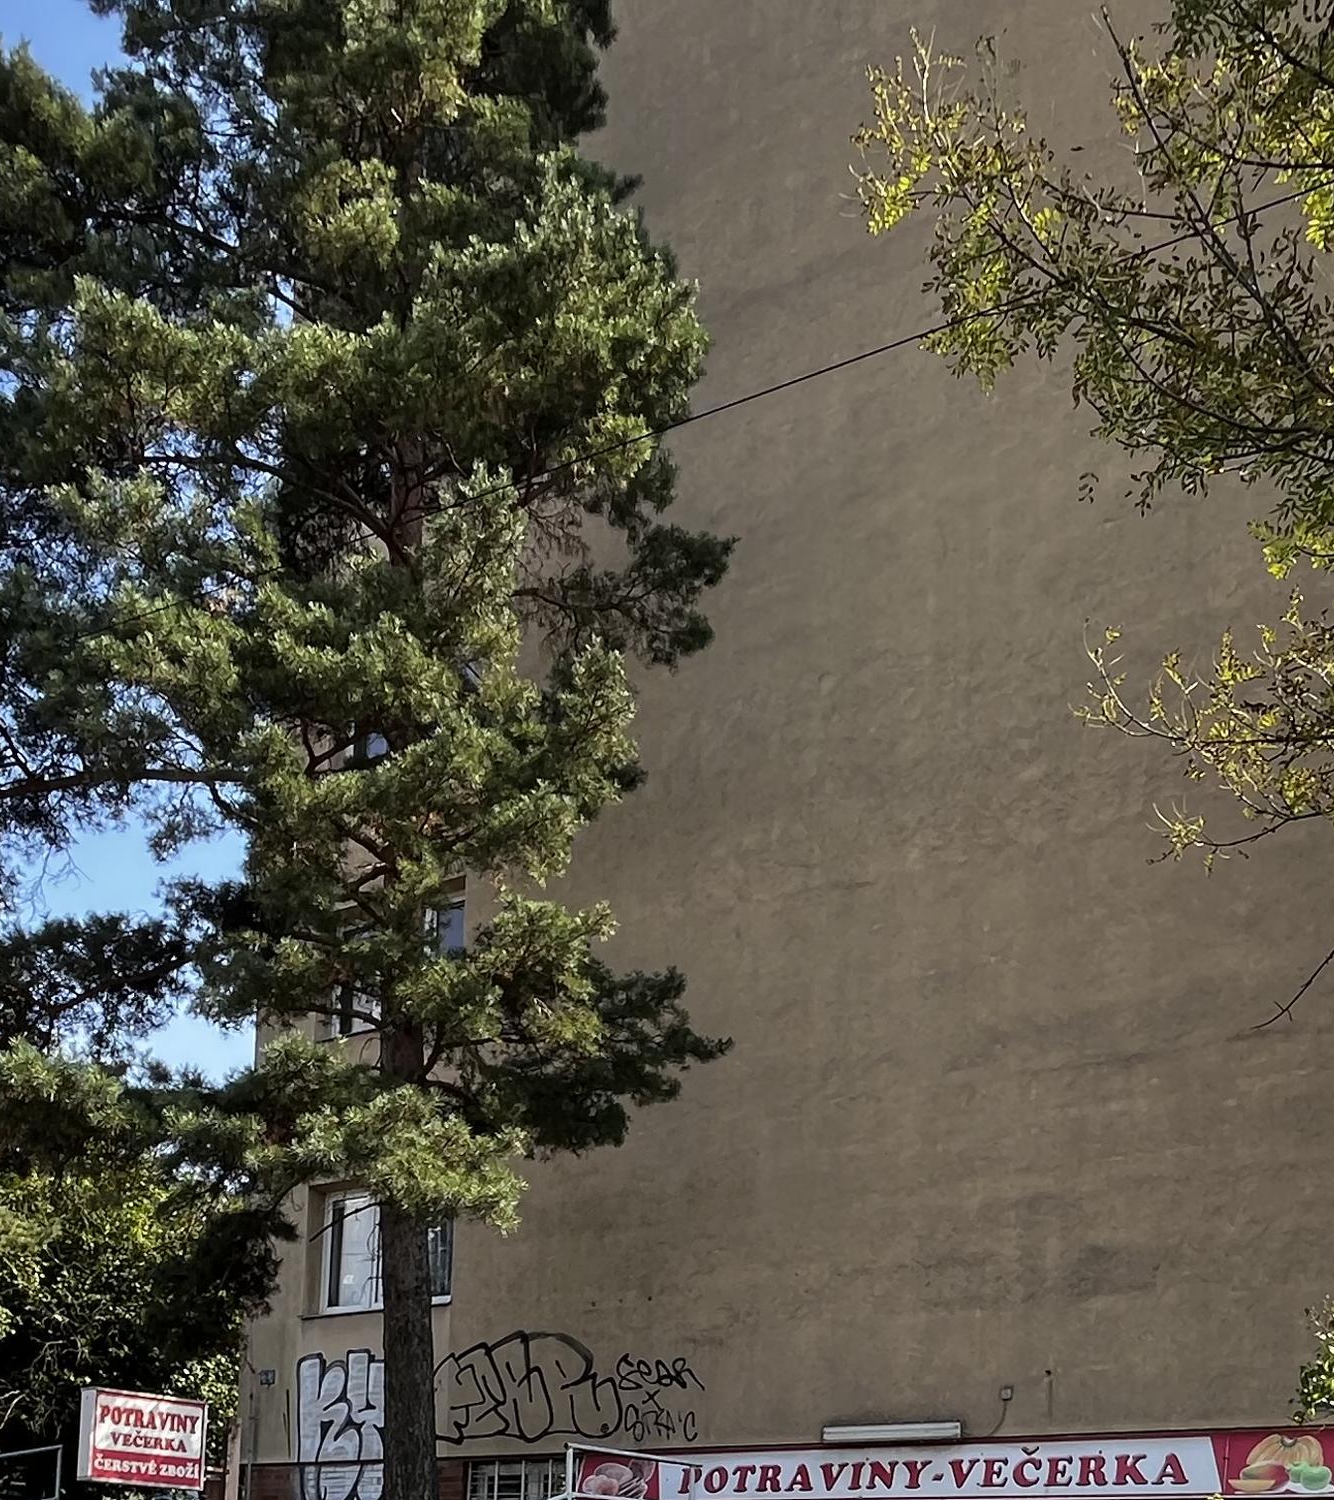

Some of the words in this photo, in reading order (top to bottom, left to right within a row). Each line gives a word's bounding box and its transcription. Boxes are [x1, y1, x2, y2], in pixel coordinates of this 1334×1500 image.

[98, 1405, 200, 1434] POTRAVINY
[110, 1430, 187, 1453] VEČERKA
[93, 1453, 158, 1475] ČERSTVÉ
[160, 1463, 199, 1479] ZBOŽÍ
